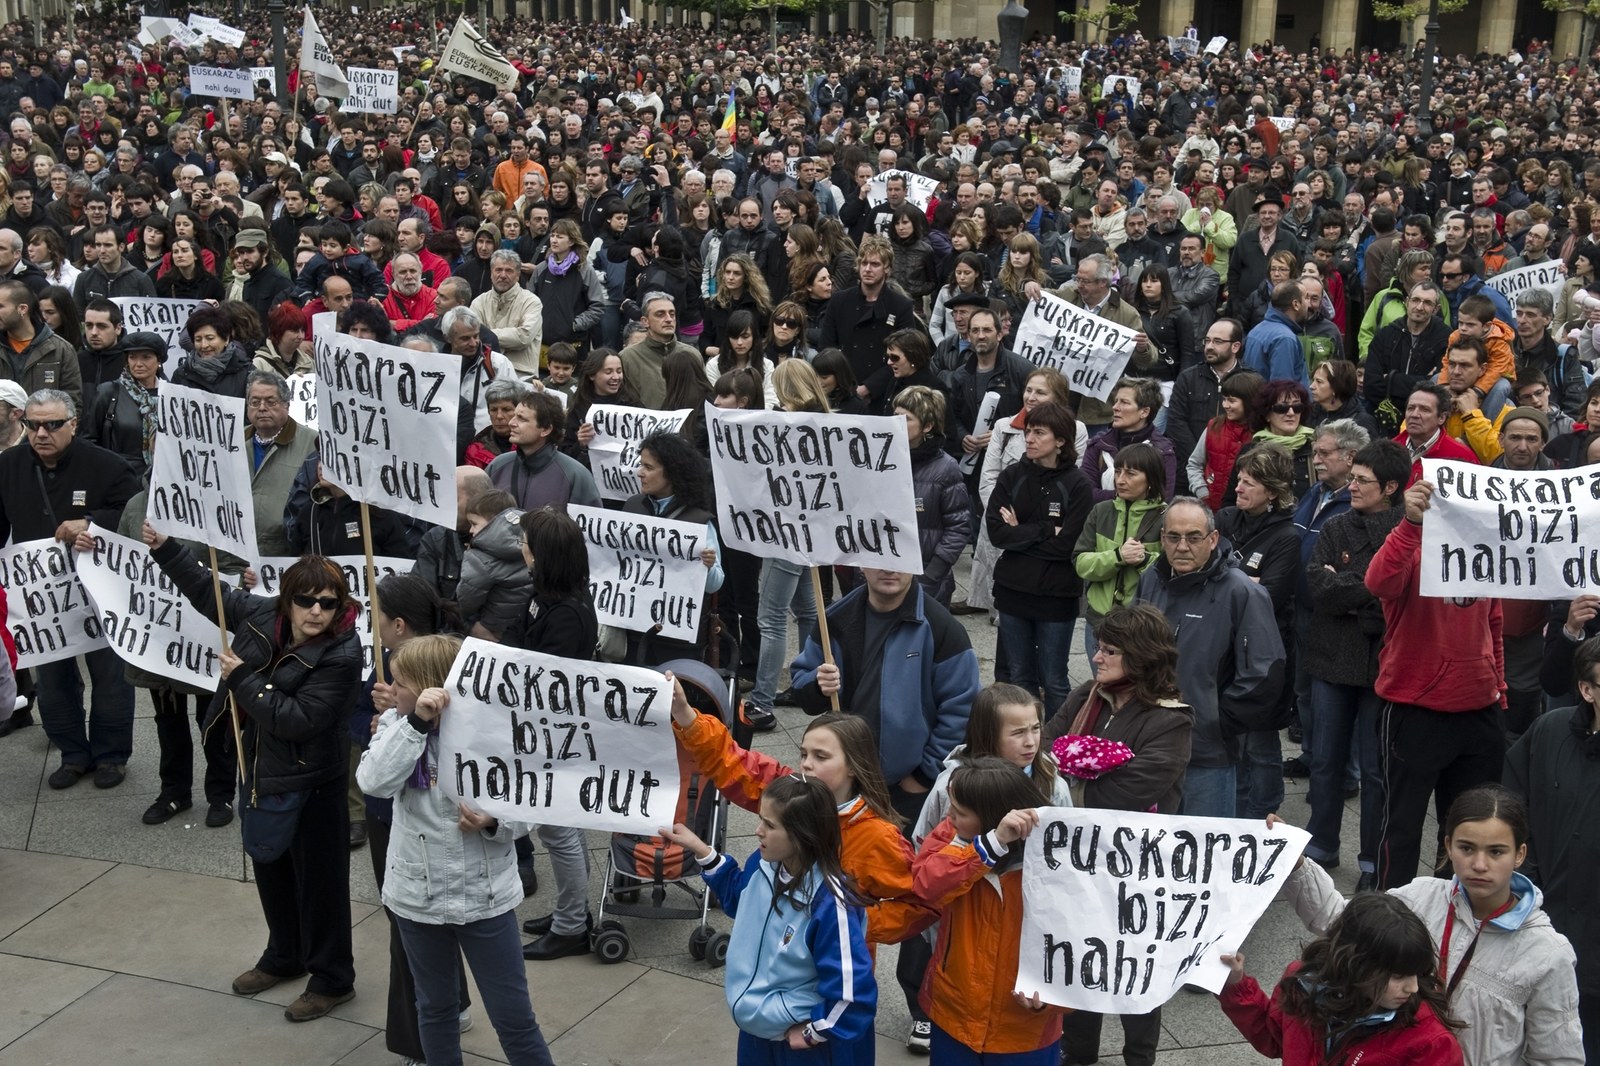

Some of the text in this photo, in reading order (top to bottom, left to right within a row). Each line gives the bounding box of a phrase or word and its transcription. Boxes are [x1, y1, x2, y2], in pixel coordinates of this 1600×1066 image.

[314, 43, 331, 53] EUSK
[451, 48, 477, 64] EUSKAL
[191, 67, 250, 81] EUSKARAZ bizi
[204, 83, 241, 95] nahi dugu
[347, 70, 394, 86] uskaraz
[356, 84, 378, 97] bizi
[372, 97, 392, 110] dut
[1487, 266, 1558, 295] uskaraz
[1033, 296, 1132, 354] euskaraz
[1052, 330, 1094, 364] bizi
[314, 334, 446, 415] uskaraz
[1020, 341, 1110, 392] nahi dut
[158, 394, 239, 454] uskaraz
[329, 390, 391, 450] bizi
[178, 440, 222, 492] bizi
[713, 418, 897, 472] euskaraz
[380, 455, 441, 508] dut
[601, 465, 640, 494] nahi
[766, 467, 844, 512] bizi
[1436, 466, 1600, 505] euskara
[154, 481, 246, 545] nahi dut
[728, 505, 901, 557] nahi dut
[1498, 503, 1579, 545] bizi
[616, 550, 665, 588] bizi
[1441, 543, 1600, 588] nahi du
[22, 575, 89, 619] bizi
[129, 583, 183, 632] bizi
[651, 592, 697, 630] dut
[13, 616, 67, 656] ahi
[103, 610, 151, 656] ahi
[166, 636, 219, 677] dut
[456, 650, 659, 726] euskaraz
[511, 710, 597, 761] bizi
[454, 753, 659, 817] nahi dut
[1043, 820, 1288, 886] euskaraz
[1118, 881, 1211, 942] bizi
[1043, 933, 1156, 996] nahi
